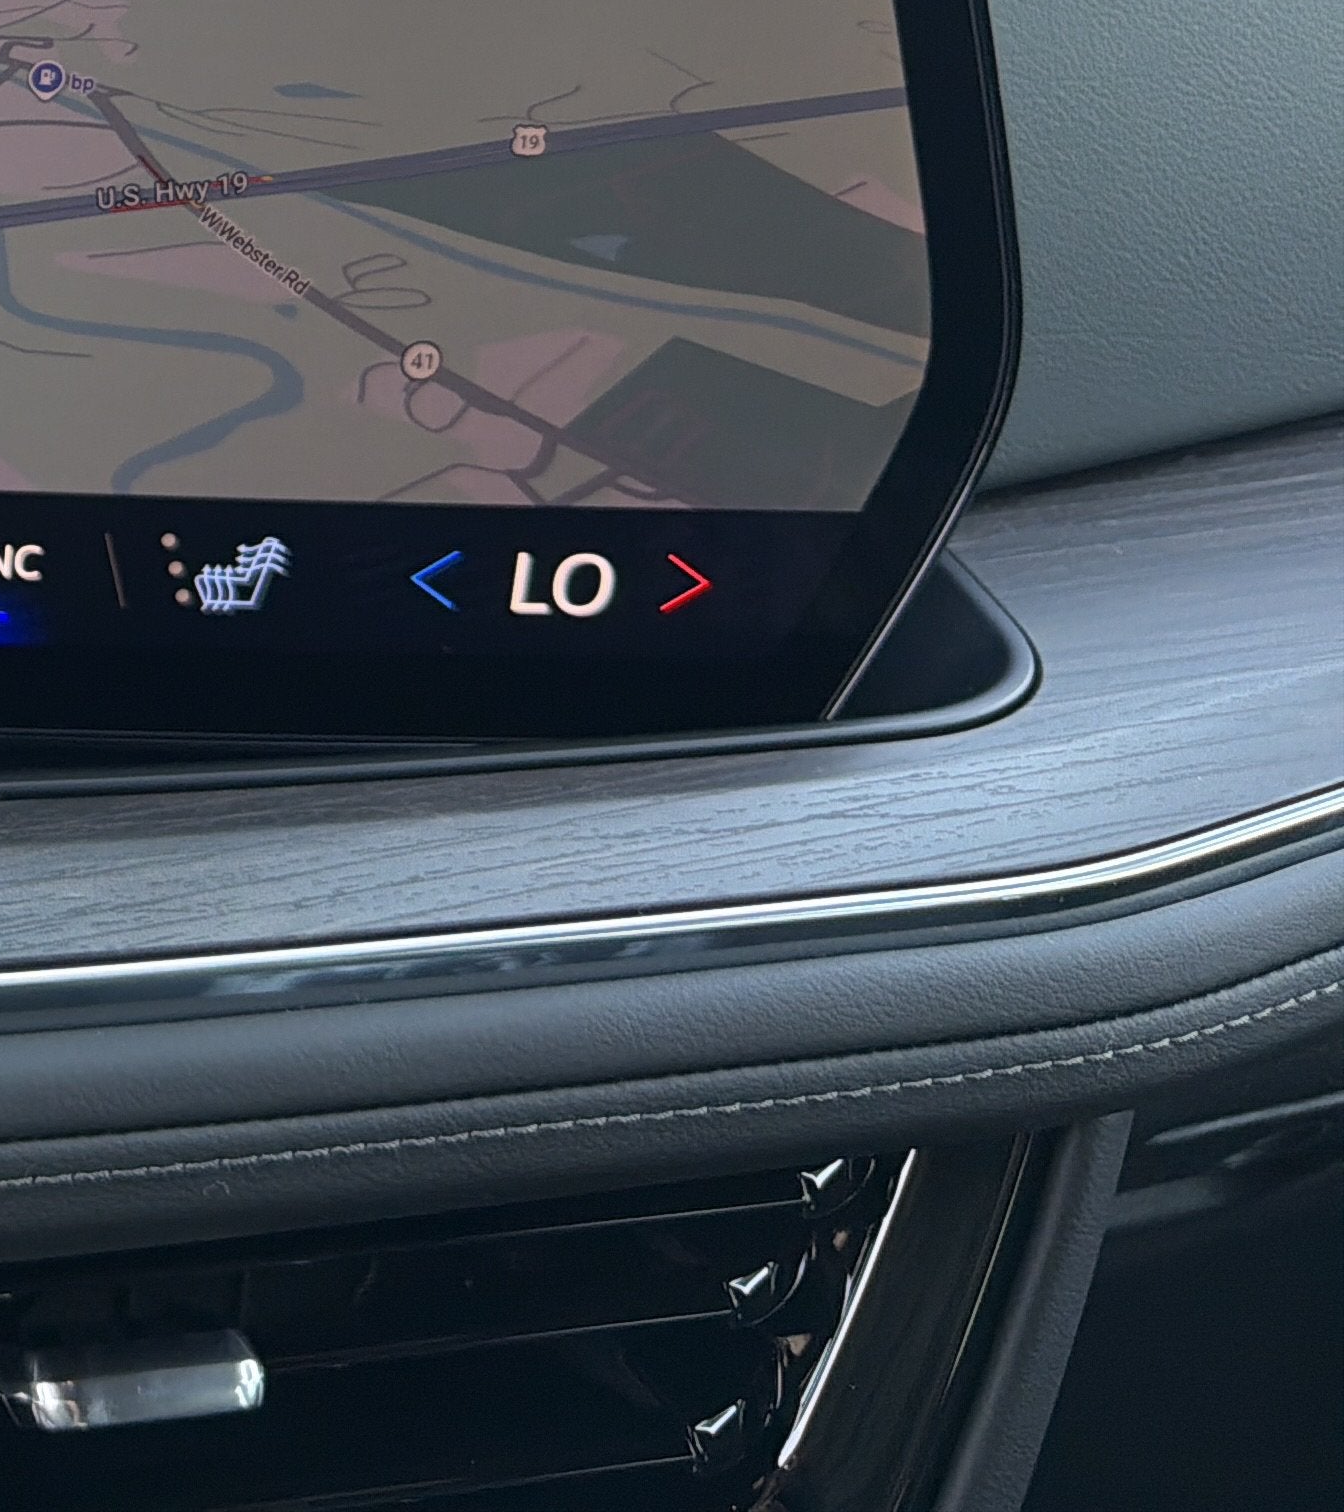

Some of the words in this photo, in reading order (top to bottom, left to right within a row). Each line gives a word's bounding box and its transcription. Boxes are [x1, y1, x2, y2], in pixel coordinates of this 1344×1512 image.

[71, 72, 94, 94] bp
[520, 134, 540, 150] 19
[96, 184, 146, 209] U.S.
[154, 180, 209, 204] Hwy
[216, 172, 248, 196] 19
[201, 207, 222, 229] W
[220, 221, 283, 277] Webster
[283, 269, 310, 296] Rd
[411, 352, 436, 372] 41
[510, 552, 614, 616] LO
